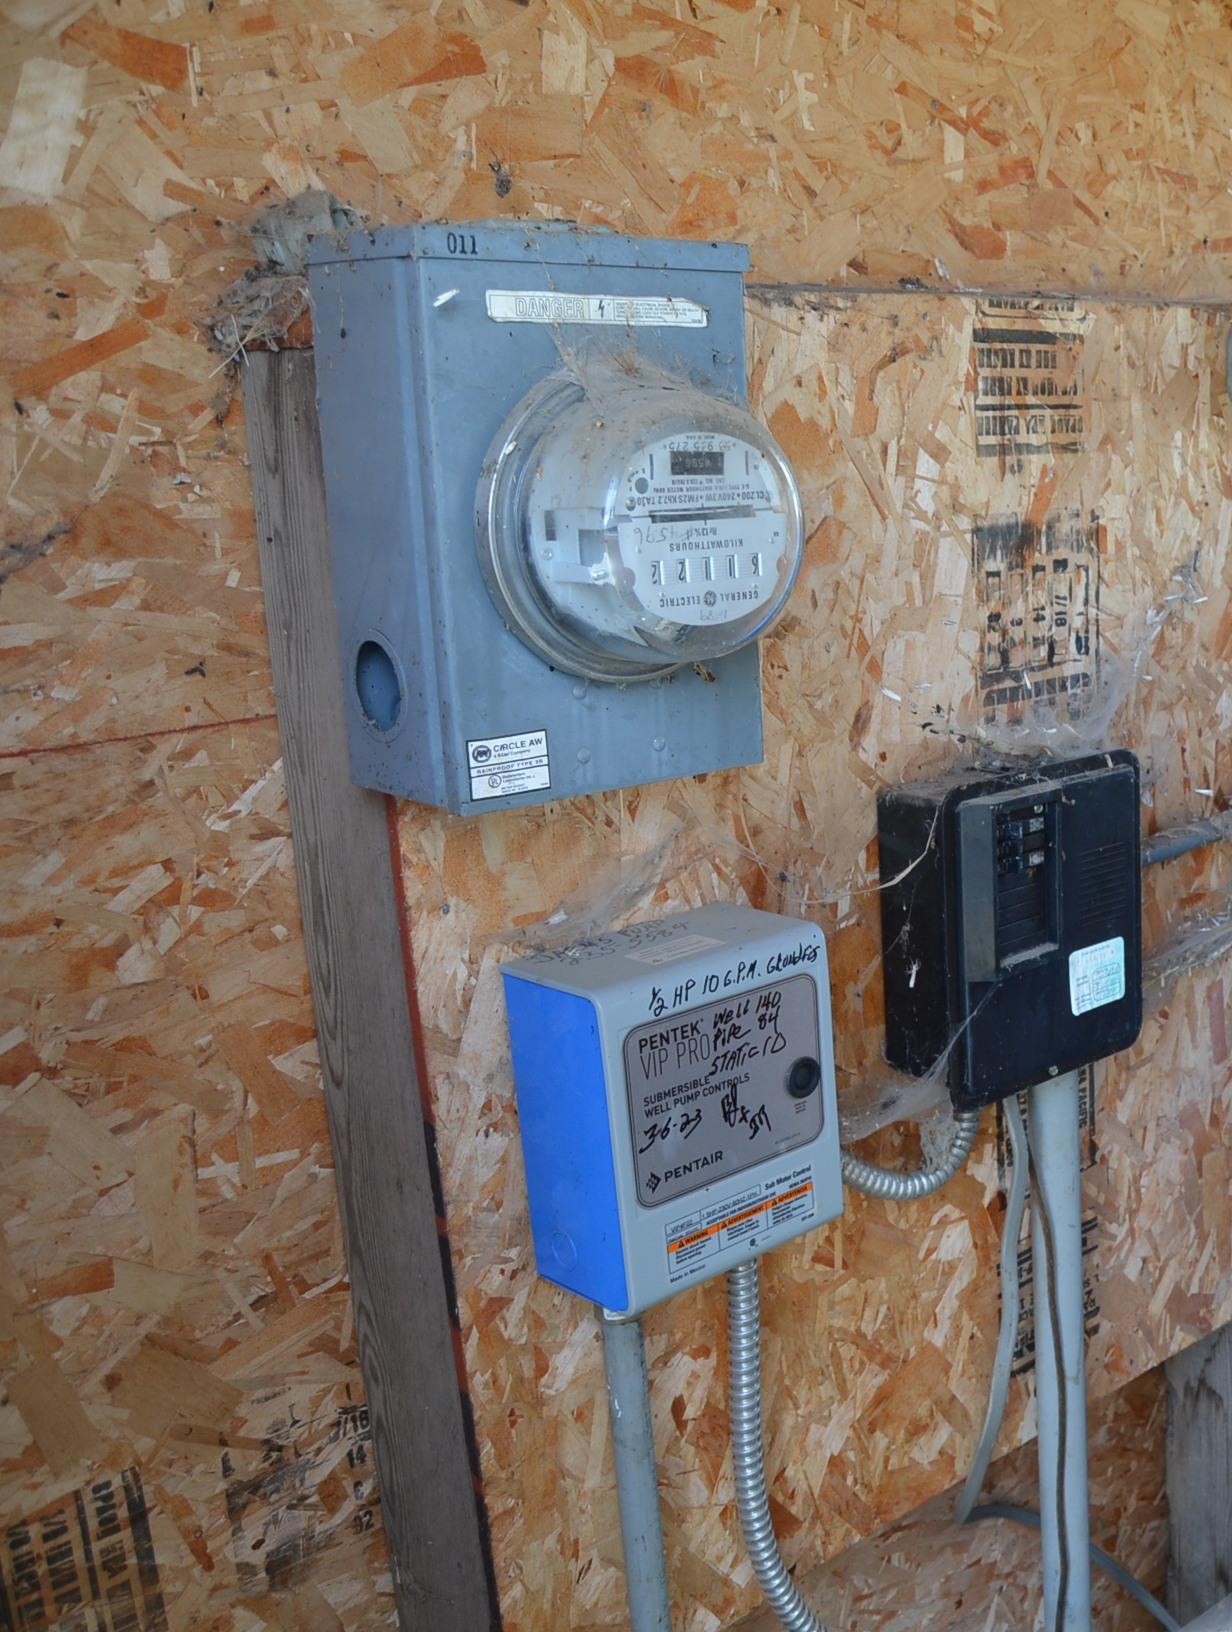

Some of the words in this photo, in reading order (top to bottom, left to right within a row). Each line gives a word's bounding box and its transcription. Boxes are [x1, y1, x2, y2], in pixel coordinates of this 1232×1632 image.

[515, 297, 585, 319] DANGER
[669, 538, 743, 552] KILOWATTHOURS
[659, 596, 701, 608] ELECTRIC
[719, 590, 758, 603] GENERAL
[493, 740, 526, 752] CIRCLE
[529, 737, 543, 746] AW
[673, 979, 696, 1008] HP
[702, 974, 719, 995] 10
[638, 1019, 704, 1055] PENTEK
[640, 1047, 669, 1081] VIP
[676, 1033, 711, 1066] PRO
[644, 1075, 710, 1107] SUBMERSIBLE
[644, 1101, 672, 1119] WELL
[674, 1090, 700, 1108] PUMP
[703, 1072, 750, 1097] CONTROLS
[664, 1150, 723, 1182] PENTAIR
[792, 1165, 811, 1179] Control
